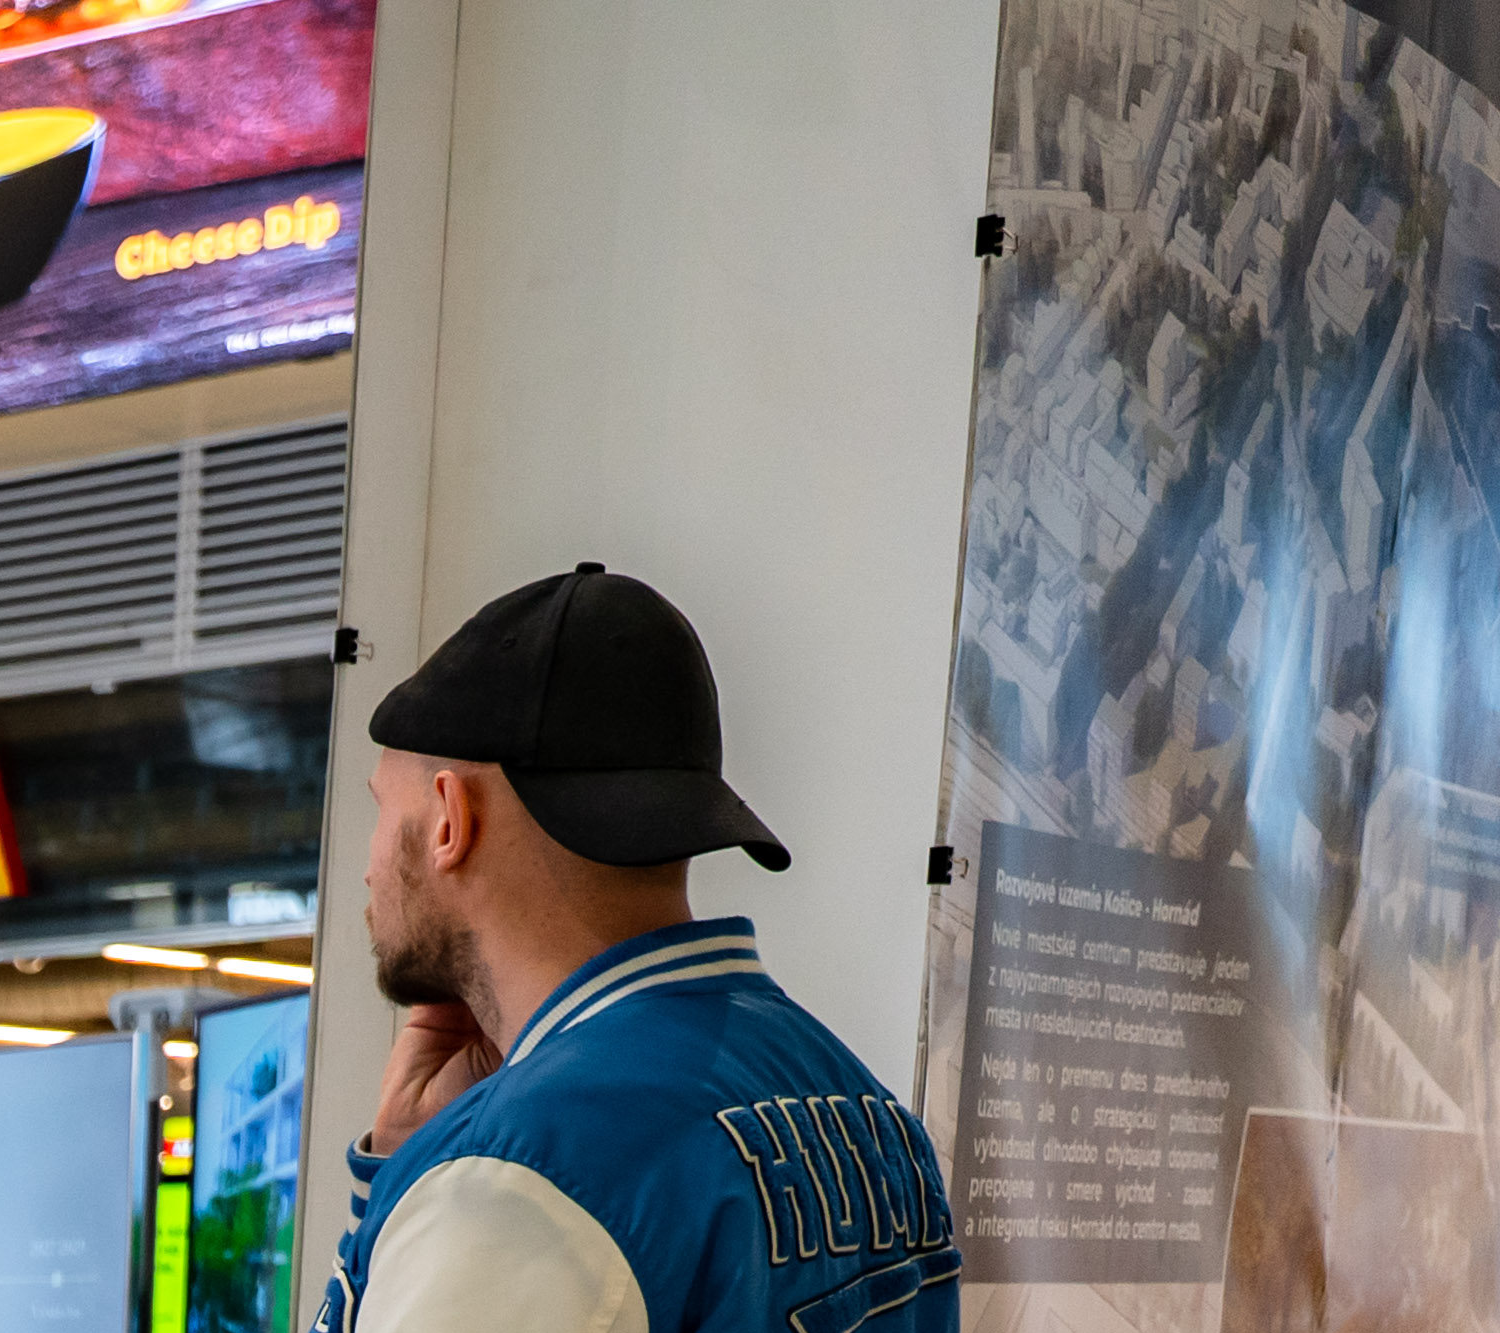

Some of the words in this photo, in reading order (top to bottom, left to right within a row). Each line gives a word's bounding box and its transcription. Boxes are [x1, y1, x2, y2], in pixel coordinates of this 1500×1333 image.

[995, 867, 1056, 906] Rozvojové
[1058, 879, 1101, 911] územie
[1103, 886, 1141, 918] Košice
[1152, 897, 1200, 927] Hornád
[992, 921, 1021, 950] Nové
[1027, 929, 1077, 958] mestské
[1082, 939, 1131, 964] centrum
[1136, 944, 1206, 981] predstavuje
[1210, 951, 1250, 983] jeden
[981, 1053, 1017, 1086] Nejde
[1060, 1065, 1113, 1090] premenu
